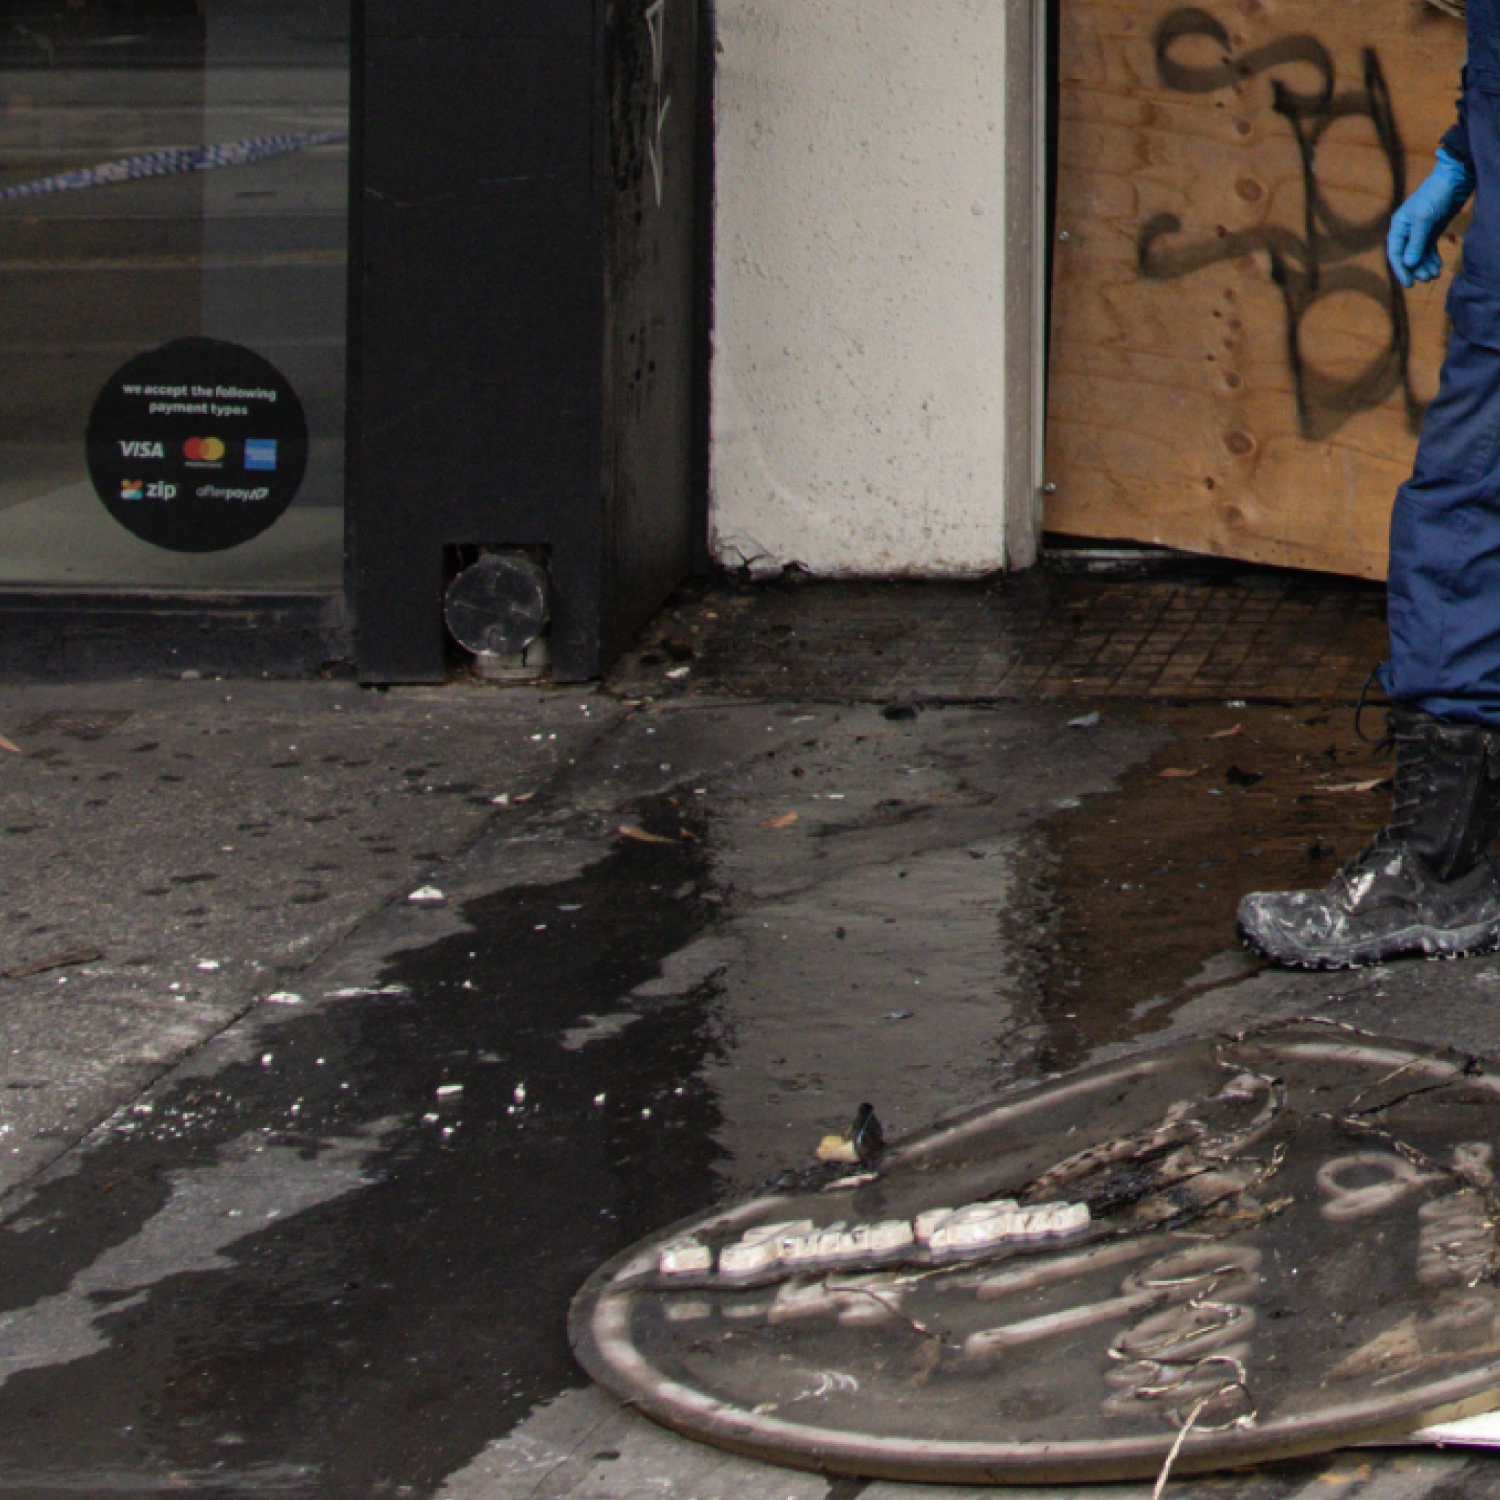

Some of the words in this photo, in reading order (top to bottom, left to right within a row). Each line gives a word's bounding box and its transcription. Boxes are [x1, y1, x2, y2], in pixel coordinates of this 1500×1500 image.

[123, 384, 142, 395] we
[143, 384, 188, 398] accept
[190, 384, 214, 398] the
[215, 385, 276, 402] following
[148, 401, 208, 416] payment
[210, 402, 249, 417] types
[117, 440, 165, 459] VISA
[146, 480, 177, 502] zip
[195, 484, 251, 501] afterpay
